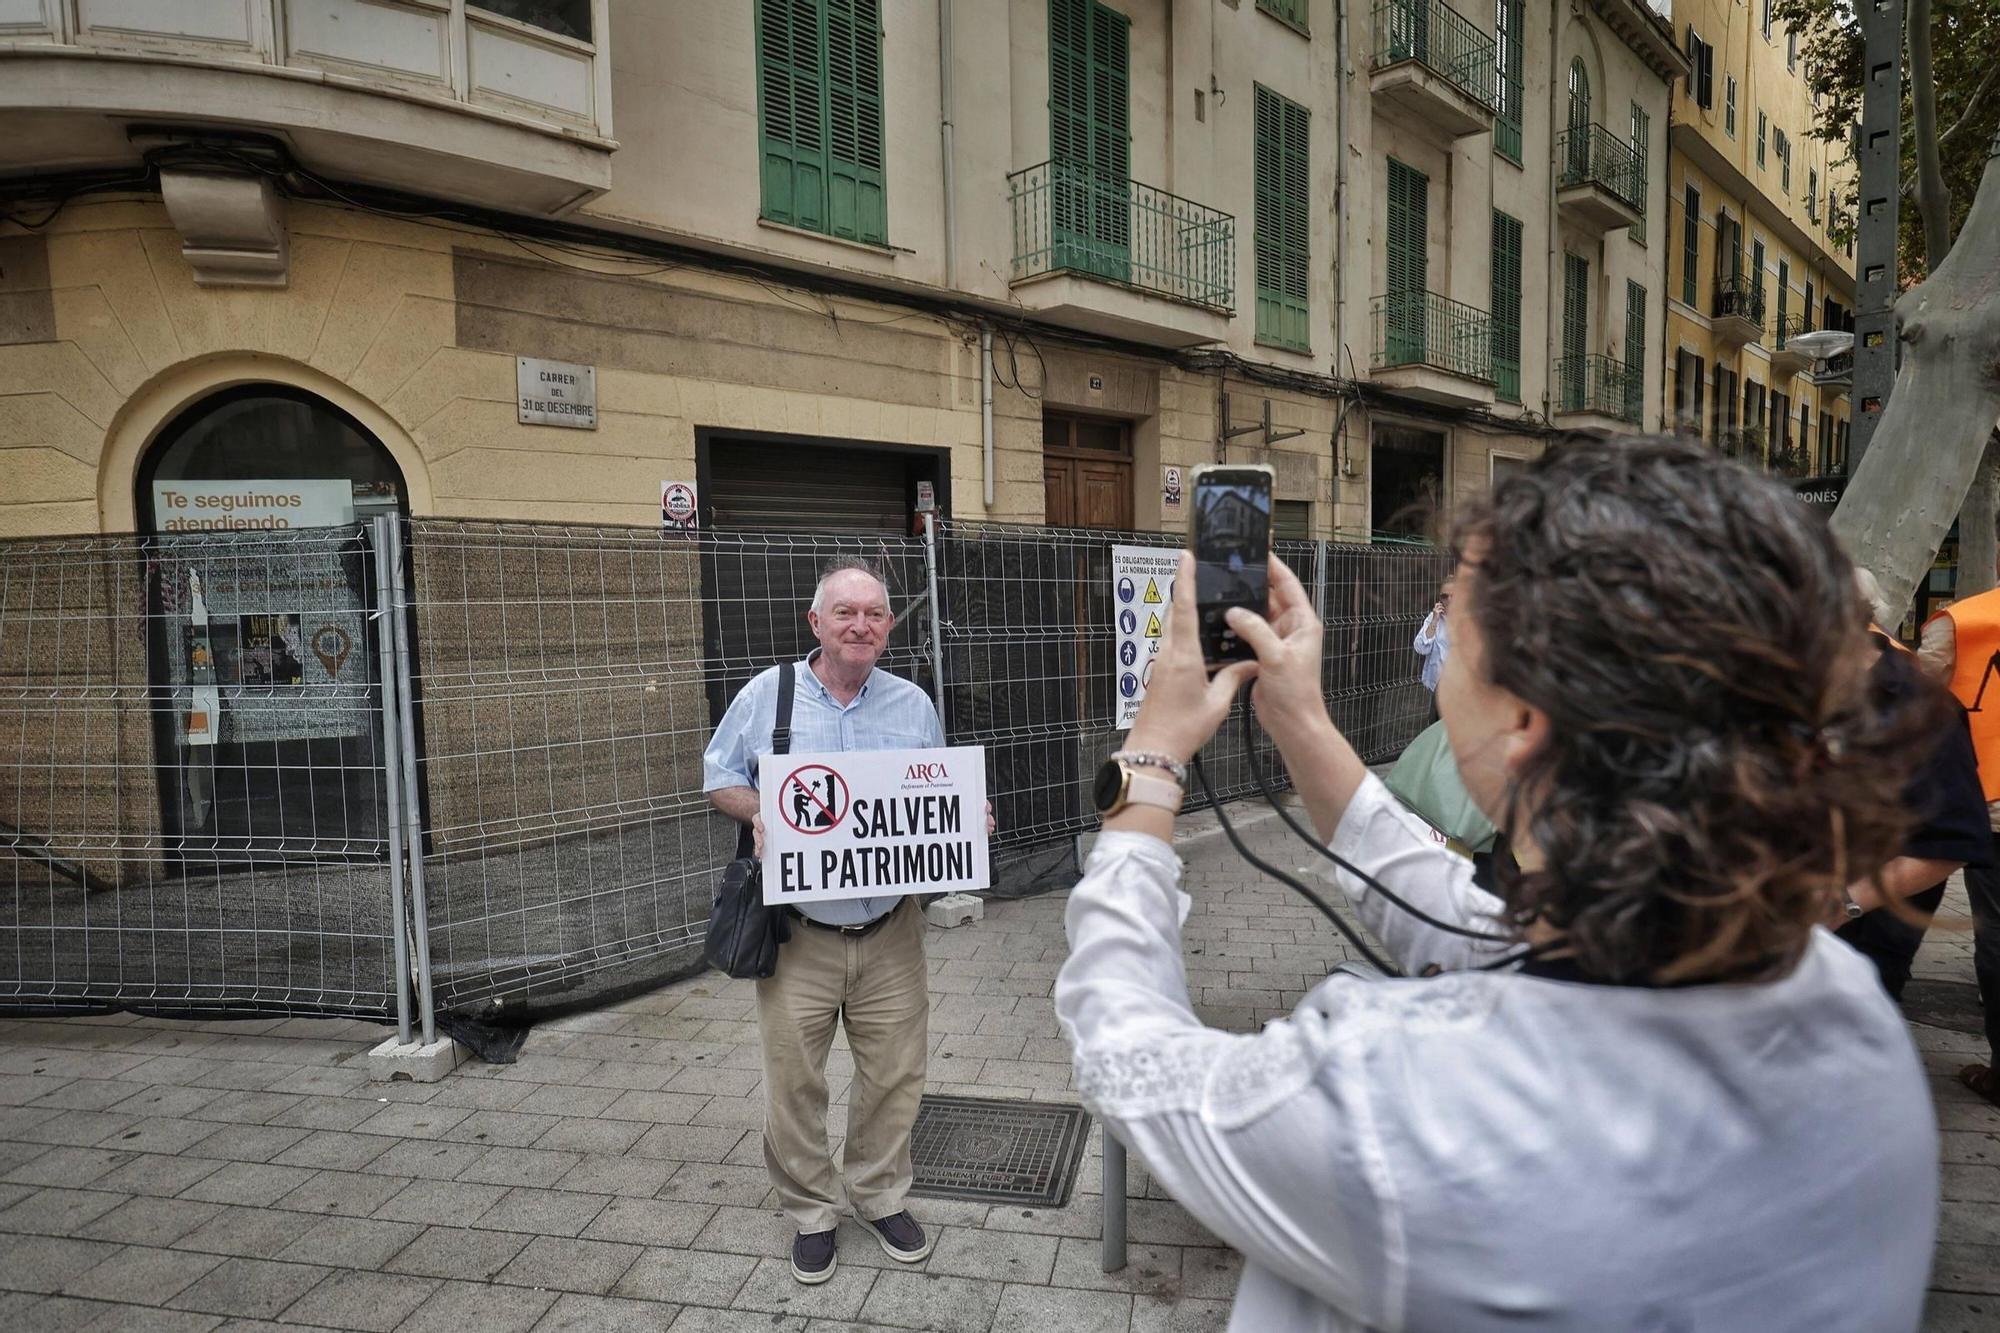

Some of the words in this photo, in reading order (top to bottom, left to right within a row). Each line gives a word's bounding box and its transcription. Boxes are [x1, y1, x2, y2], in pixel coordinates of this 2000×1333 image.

[540, 371, 575, 385] CARRER
[551, 388, 564, 398] DEL
[522, 398, 533, 411] 31
[534, 401, 545, 412] DE
[547, 401, 593, 417] DESEMBRE
[161, 491, 188, 508] Te
[195, 490, 302, 512] seguimos
[165, 514, 289, 532] atendiendo
[1114, 555, 1121, 564] ES
[1121, 556, 1154, 566] OBLIGATORIO
[1154, 557, 1172, 567] SEGUIR
[1119, 565, 1129, 574] LAS
[1130, 566, 1150, 575] NORMAS
[1150, 566, 1157, 575] DE
[1157, 567, 1177, 576] SEGURI
[904, 762, 949, 783] ARCA
[852, 795, 961, 839] SALVEM
[780, 851, 812, 893] EL
[821, 841, 973, 889] PATRIMONI
